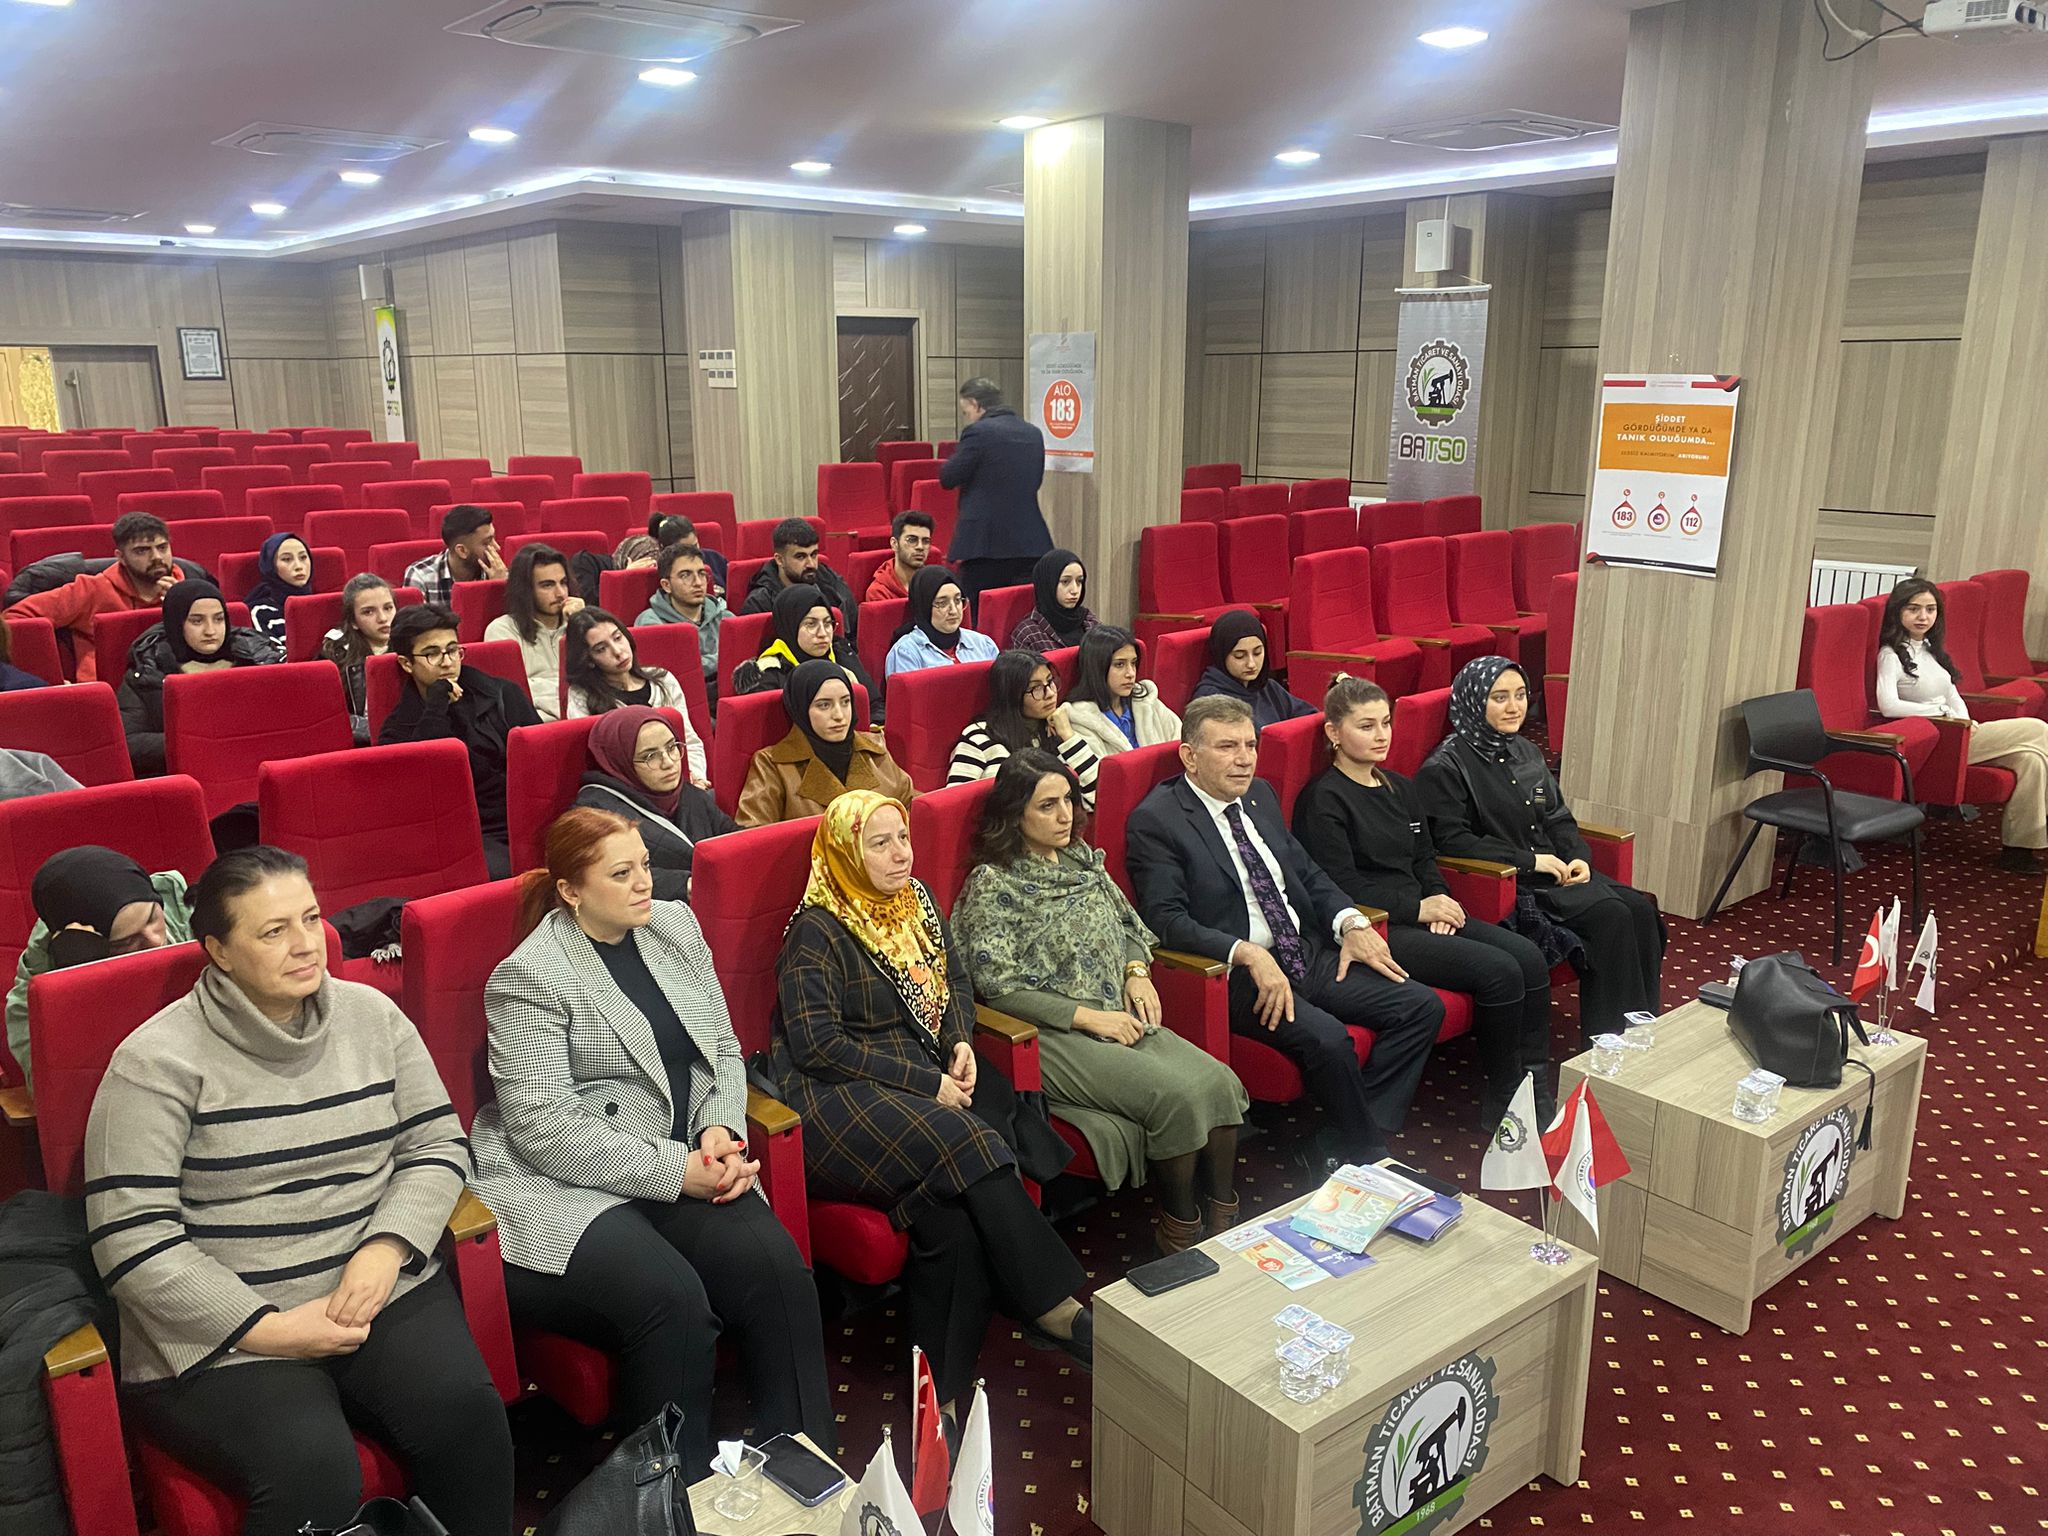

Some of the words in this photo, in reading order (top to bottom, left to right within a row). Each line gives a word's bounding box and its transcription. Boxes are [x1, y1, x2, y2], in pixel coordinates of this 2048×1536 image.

[1053, 384, 1072, 396] ALO
[1411, 367, 1421, 402] BATMAN
[1452, 380, 1464, 405] ODASI
[1050, 398, 1075, 422] 183
[1655, 413, 1686, 425] ŞİDDET
[1616, 433, 1646, 442] TANIK
[1689, 426, 1698, 434] YA
[1701, 426, 1713, 434] DA
[1399, 434, 1466, 463] BATSO
[1616, 511, 1633, 521] 183
[1685, 517, 1699, 527] 112
[1781, 1168, 1796, 1232] BATMAN
[1834, 1149, 1851, 1195] ODASI
[1456, 1358, 1487, 1407] SANAYİ
[1463, 1407, 1487, 1468] ODASI
[1365, 1445, 1386, 1527] BATMAN
[1415, 1502, 1436, 1522] 1968
